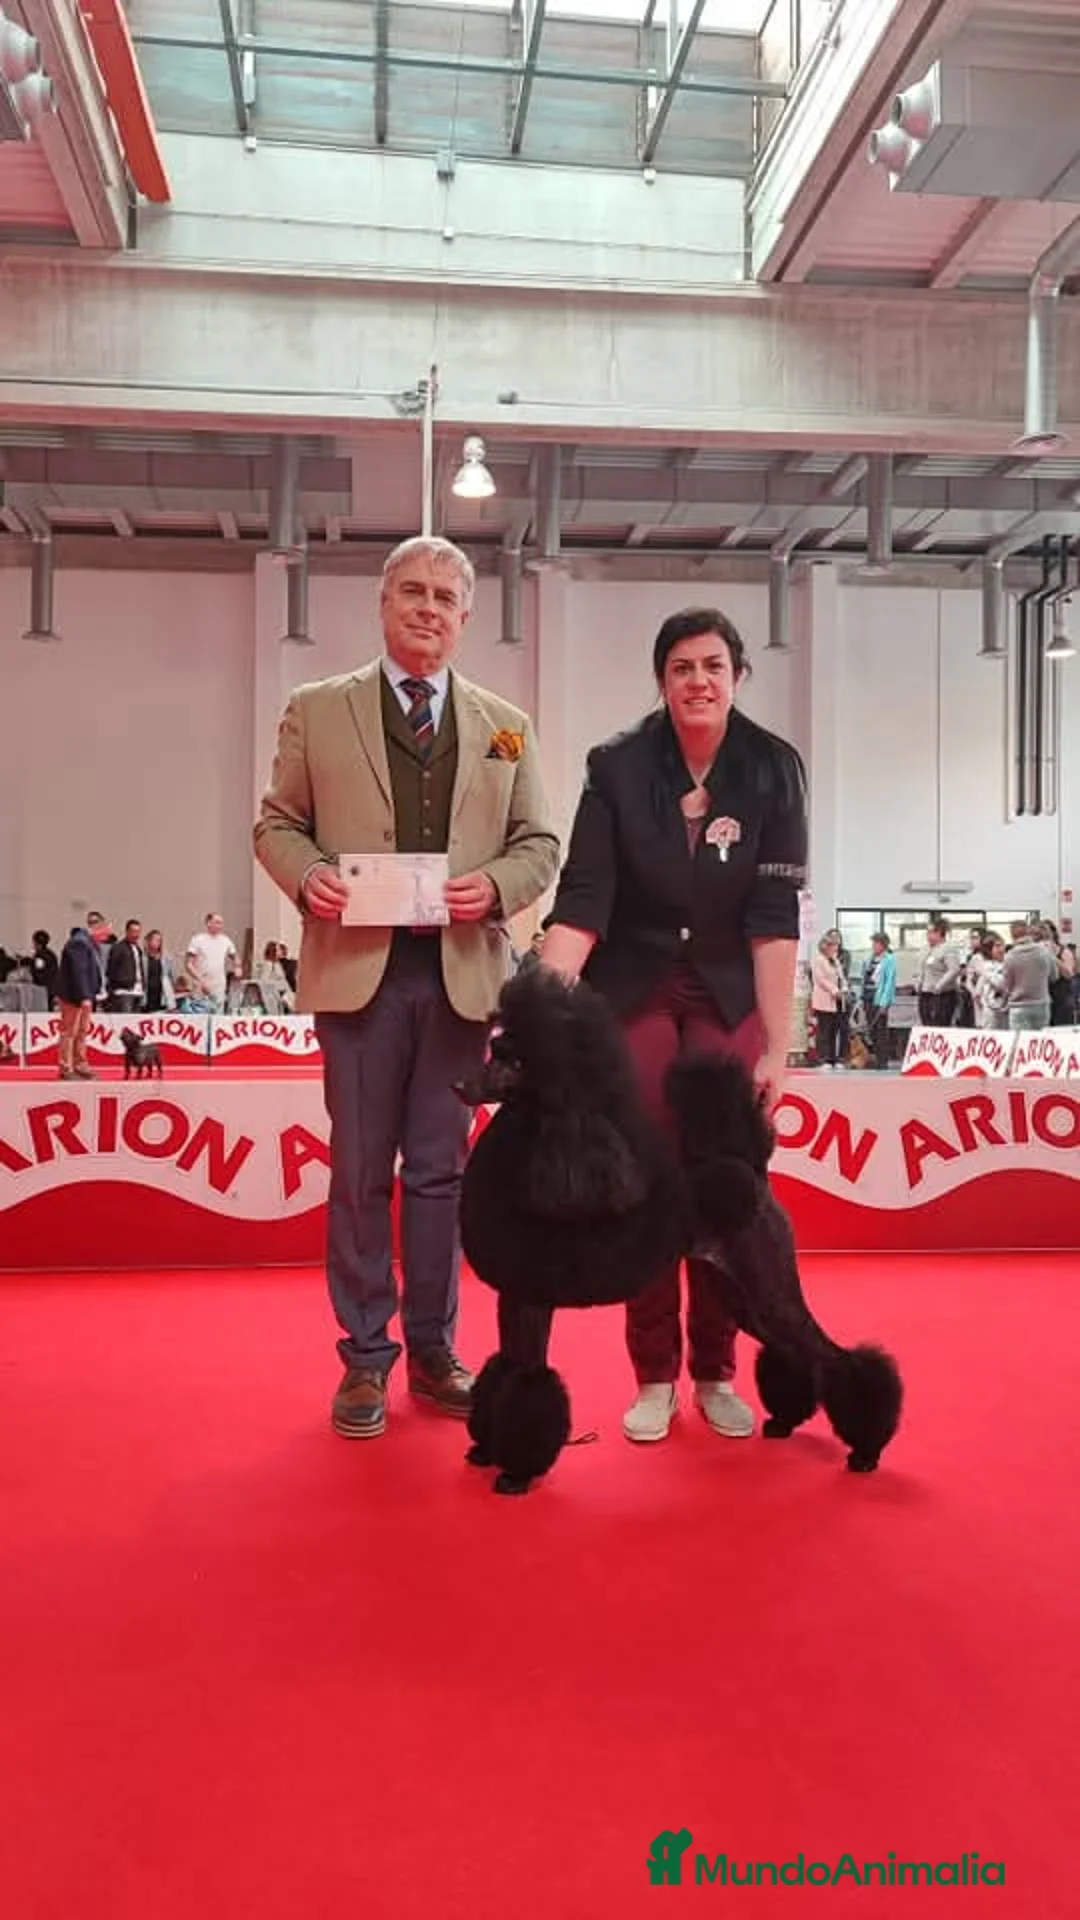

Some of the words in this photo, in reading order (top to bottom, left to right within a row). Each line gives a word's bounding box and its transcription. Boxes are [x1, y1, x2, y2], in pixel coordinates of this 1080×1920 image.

[215, 1019, 296, 1047] ARION
[908, 1032, 951, 1066] ARION
[954, 1036, 1006, 1073] ARION
[1015, 1039, 1064, 1076] ARION
